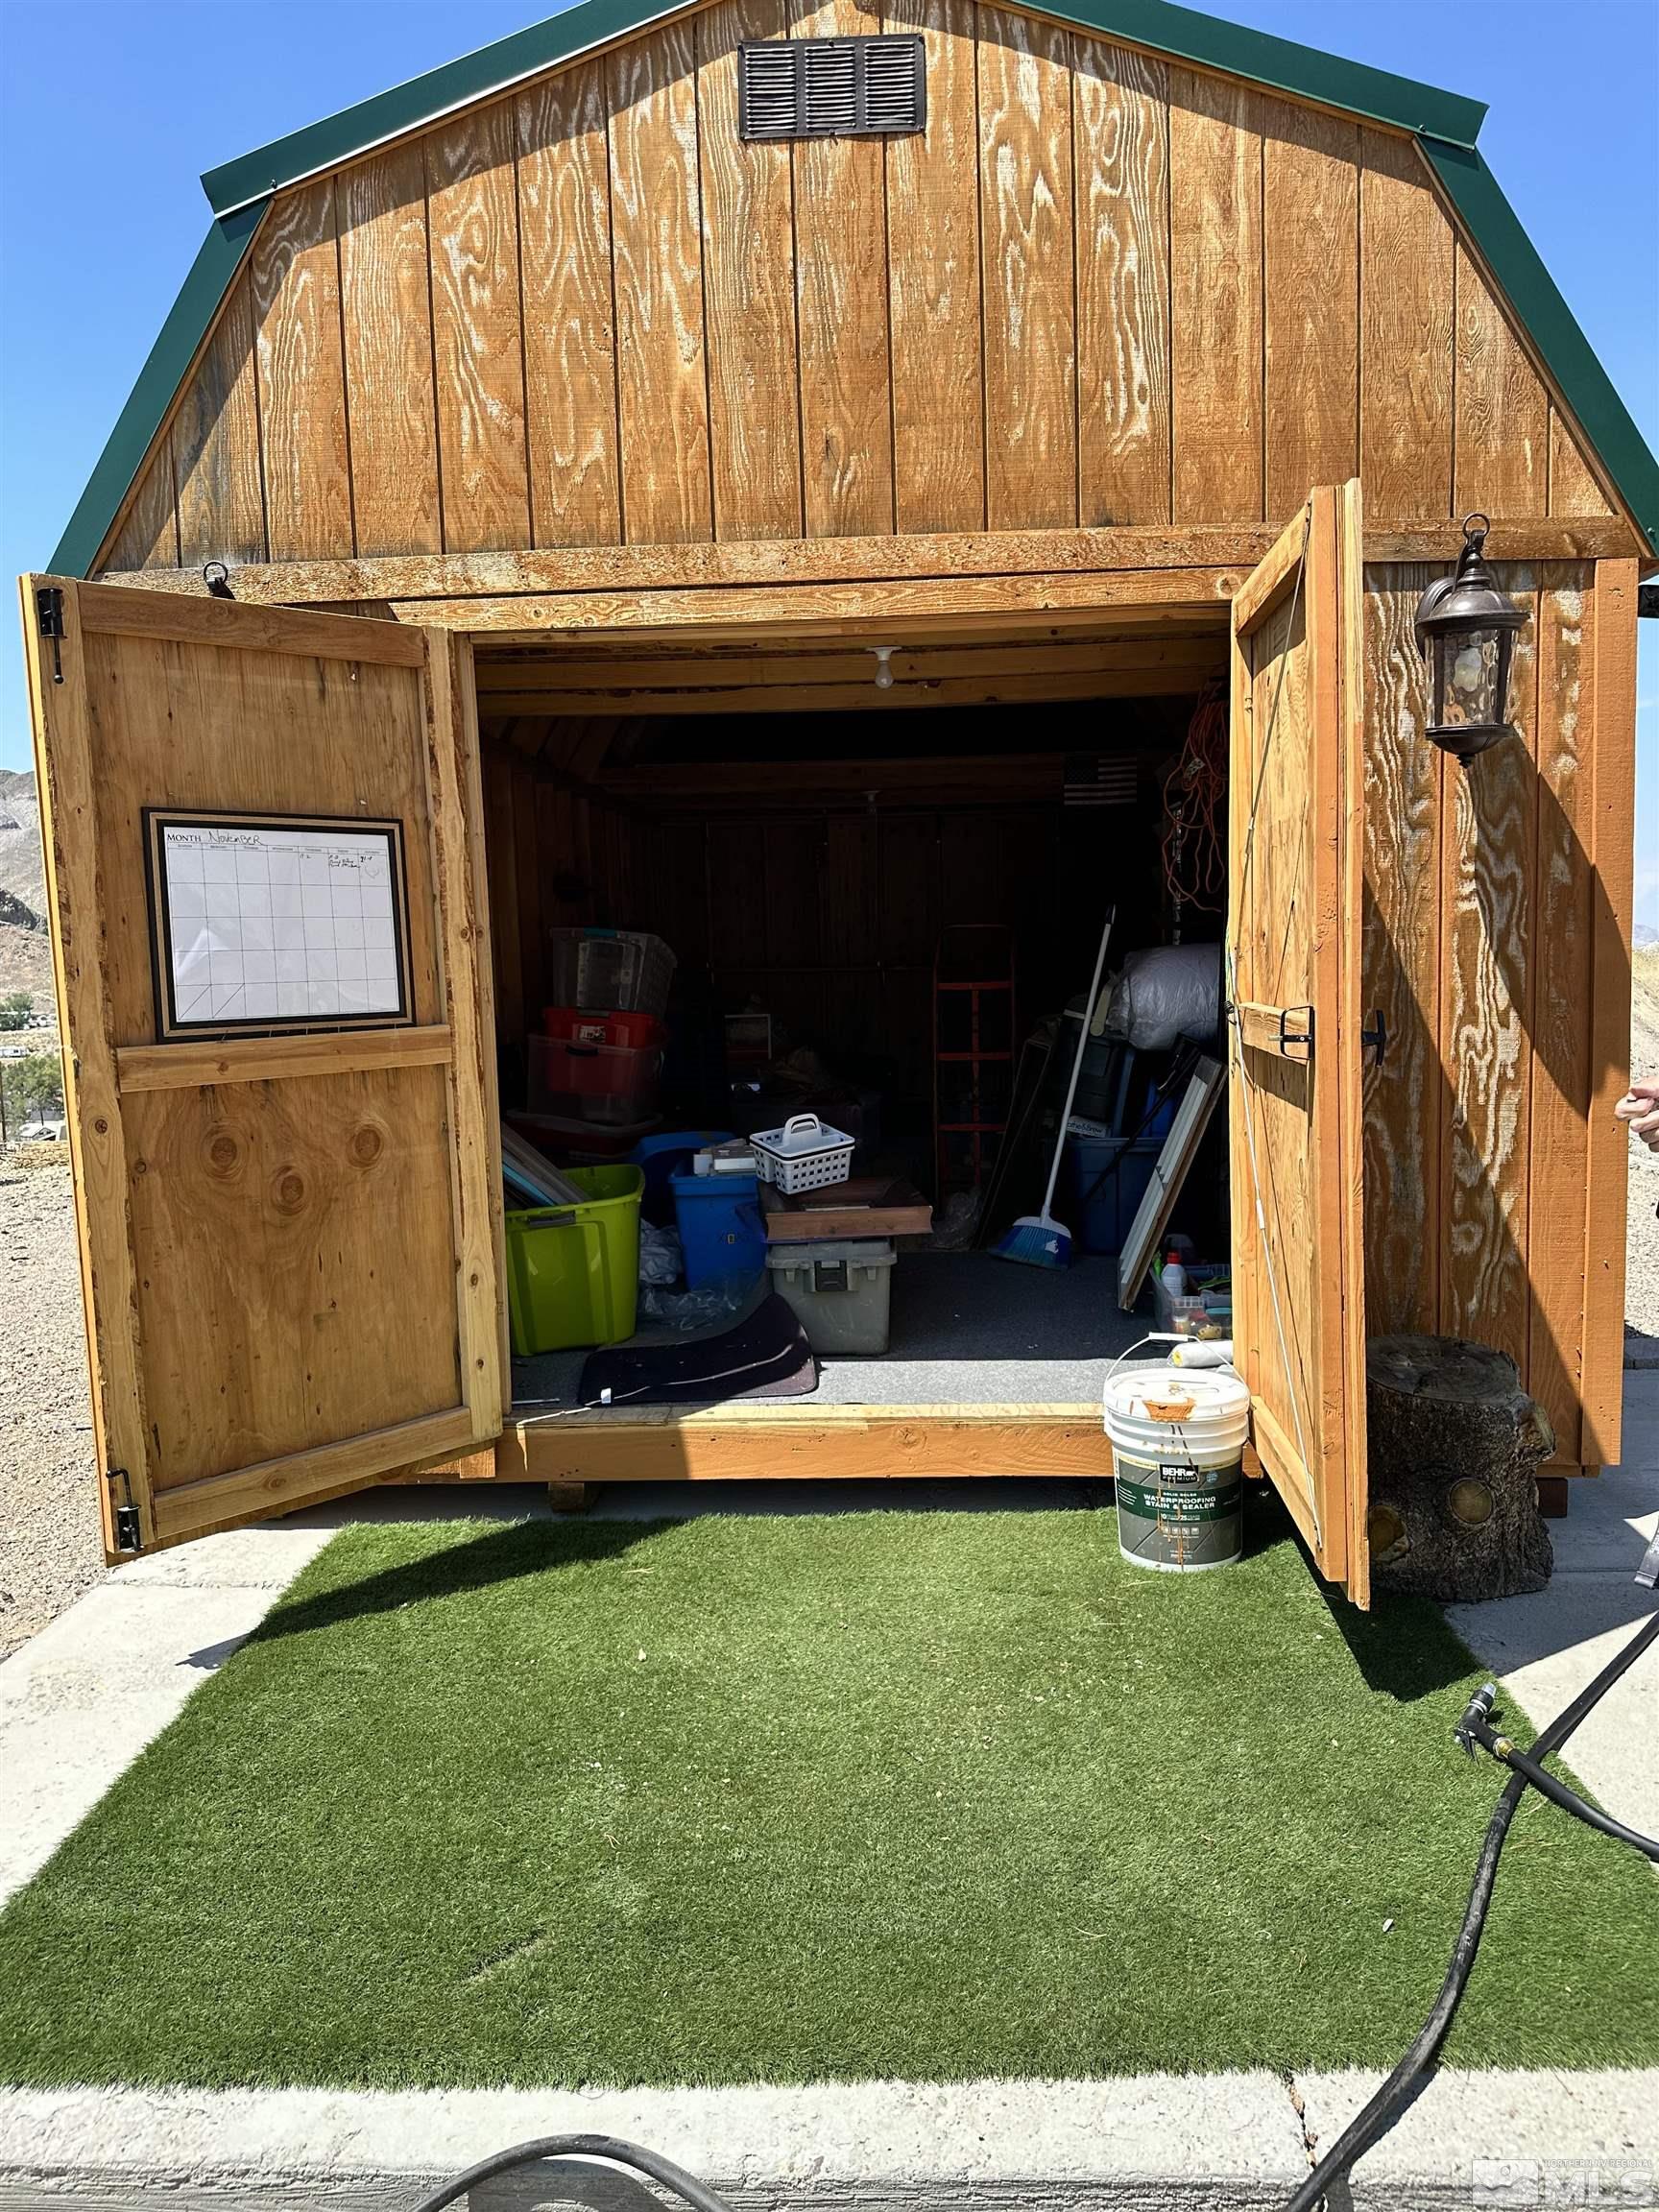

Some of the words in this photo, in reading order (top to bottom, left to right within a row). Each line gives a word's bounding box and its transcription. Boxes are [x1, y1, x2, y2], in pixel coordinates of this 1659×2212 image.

[167, 833, 201, 842] MONTH
[1163, 1467, 1185, 1476] BEHR
[1143, 1494, 1215, 1504] WATERPROOFING
[1145, 1500, 1169, 1509] STAIN
